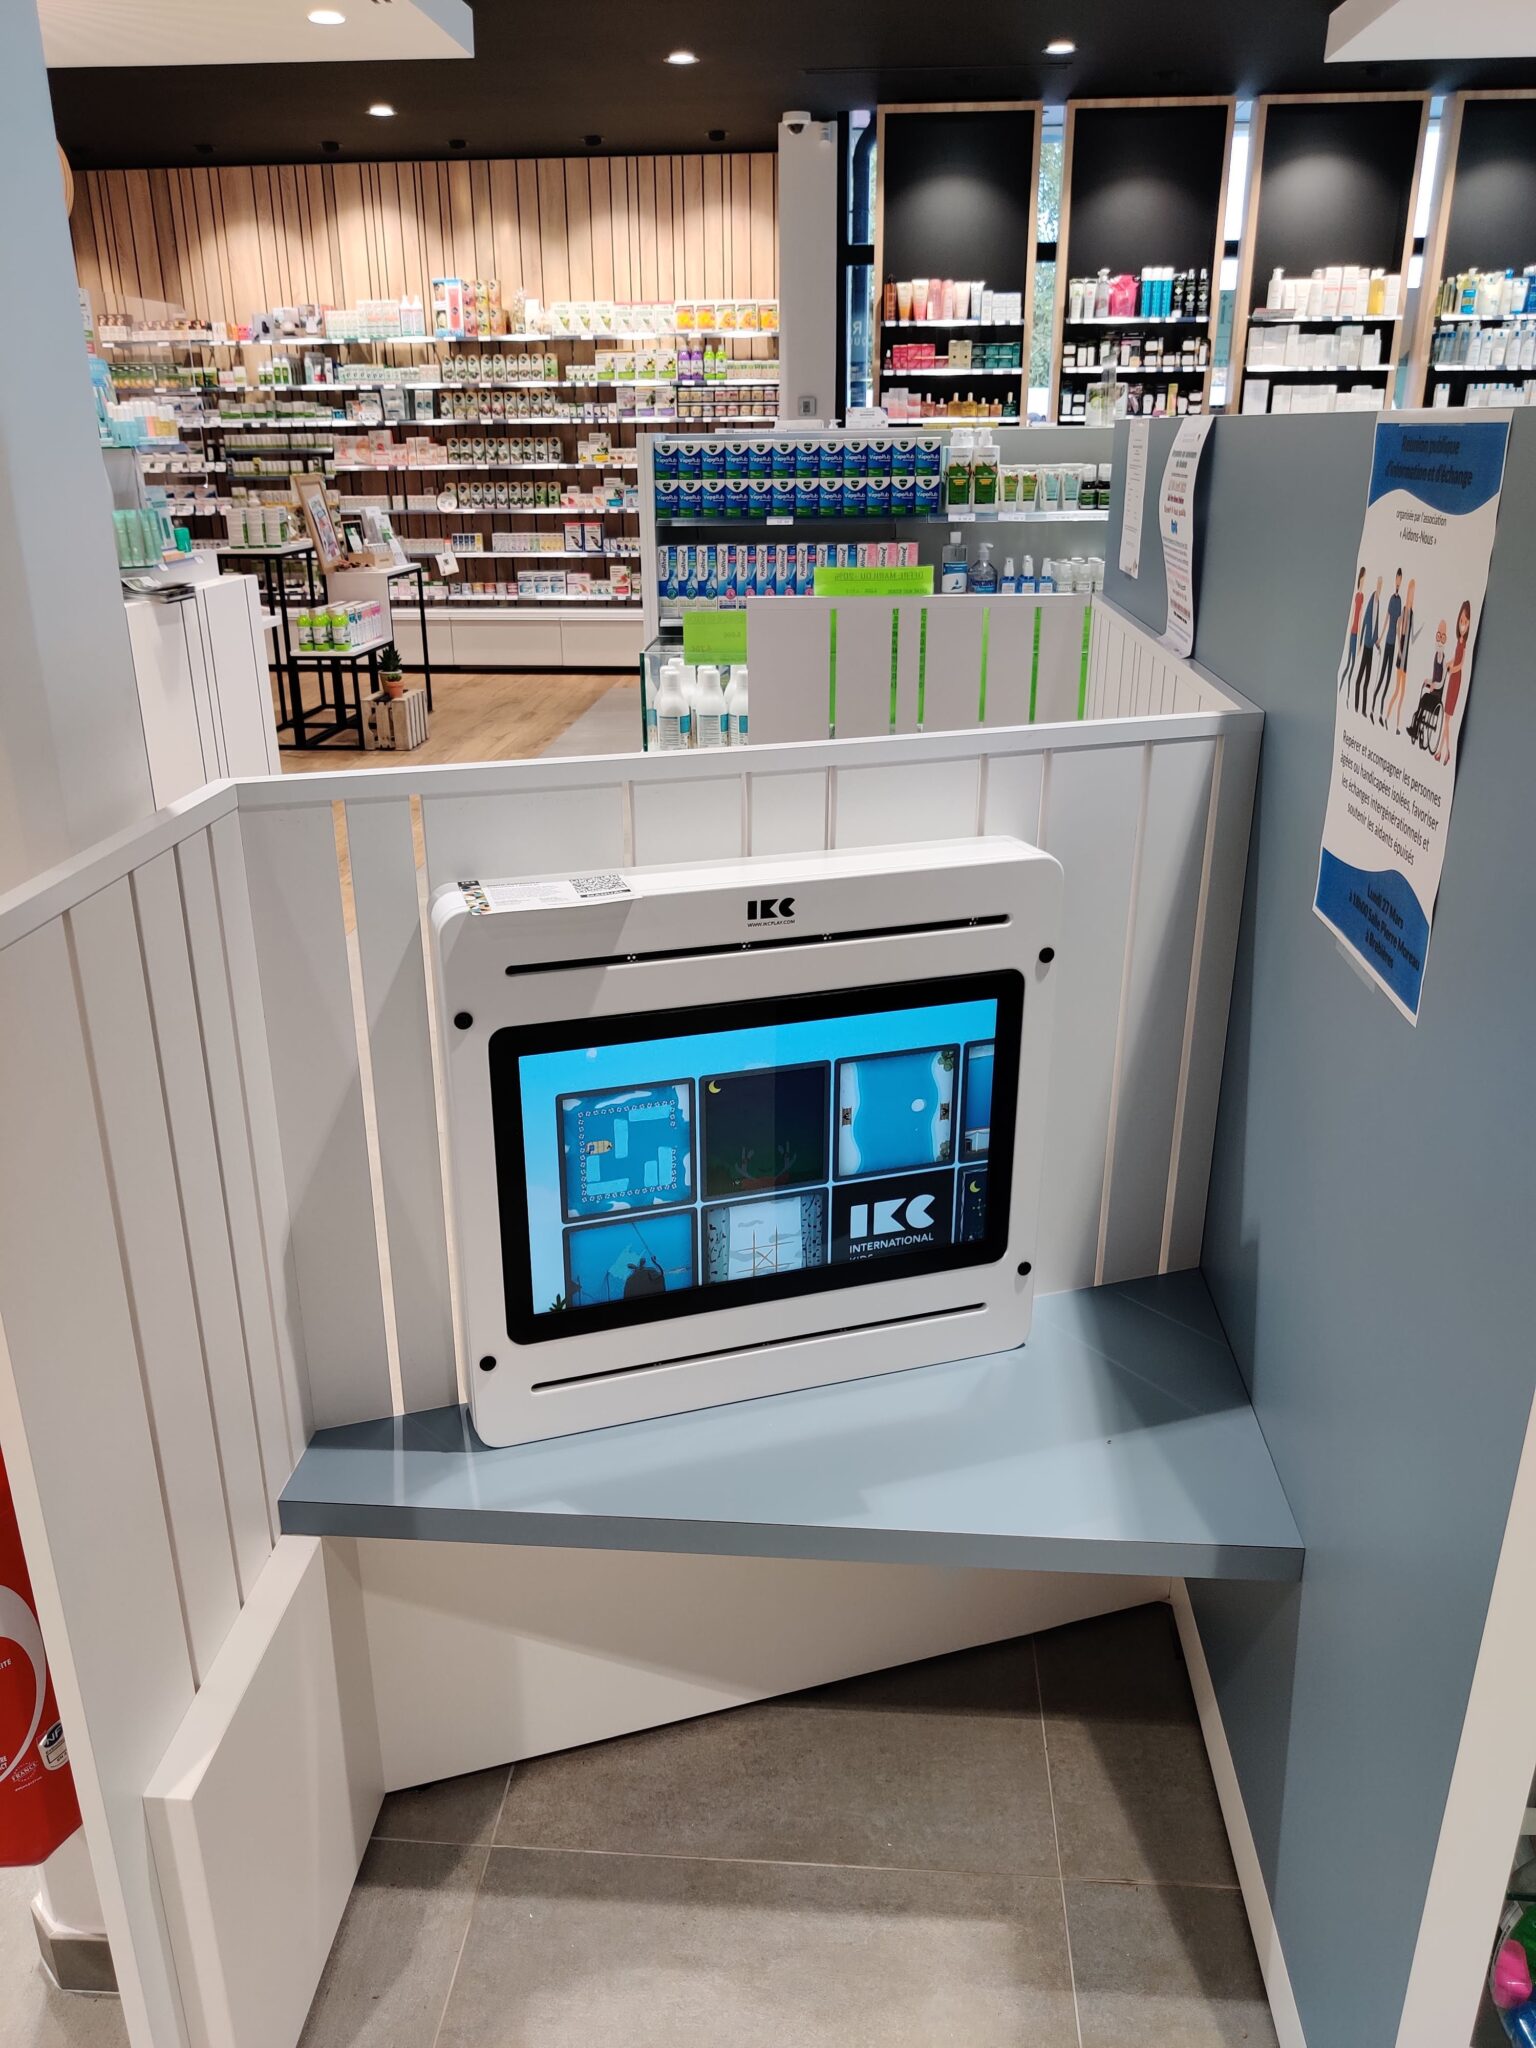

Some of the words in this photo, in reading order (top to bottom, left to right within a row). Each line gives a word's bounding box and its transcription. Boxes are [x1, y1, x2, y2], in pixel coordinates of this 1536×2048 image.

[1436, 464, 1473, 489] d'échange
[1396, 510, 1414, 521] organisée
[1421, 512, 1447, 526] l'association
[1402, 528, 1434, 545] Aidons-Nous
[1342, 730, 1361, 752] Repérer
[1362, 745, 1367, 757] et
[1367, 749, 1402, 780] accompagner
[1402, 767, 1411, 787] les
[1410, 778, 1441, 807] personnes
[1348, 777, 1370, 805] échanges
[1370, 794, 1422, 846] intergénérationnels
[1422, 838, 1430, 852] et
[1354, 763, 1360, 774] ou
[1360, 762, 1391, 797] handicapées
[1391, 785, 1411, 814] isolées,
[1411, 800, 1439, 831] favoriser
[1347, 803, 1367, 826] soutenir
[1367, 815, 1375, 833] les
[1374, 823, 1394, 849] aidants
[1393, 838, 1415, 866] épuisés
[747, 897, 796, 920] IKC
[747, 919, 796, 928] WWW.IKCPLAY.COM
[1367, 882, 1382, 908] Lundi
[1381, 898, 1390, 914] 27
[1389, 904, 1404, 930] Mars
[1368, 908, 1381, 931] Salle
[1380, 920, 1398, 949] Pierre
[1397, 937, 1419, 970] Moreau
[850, 1194, 936, 1239] IKC
[849, 1232, 934, 1254] INTERNATIONAL
